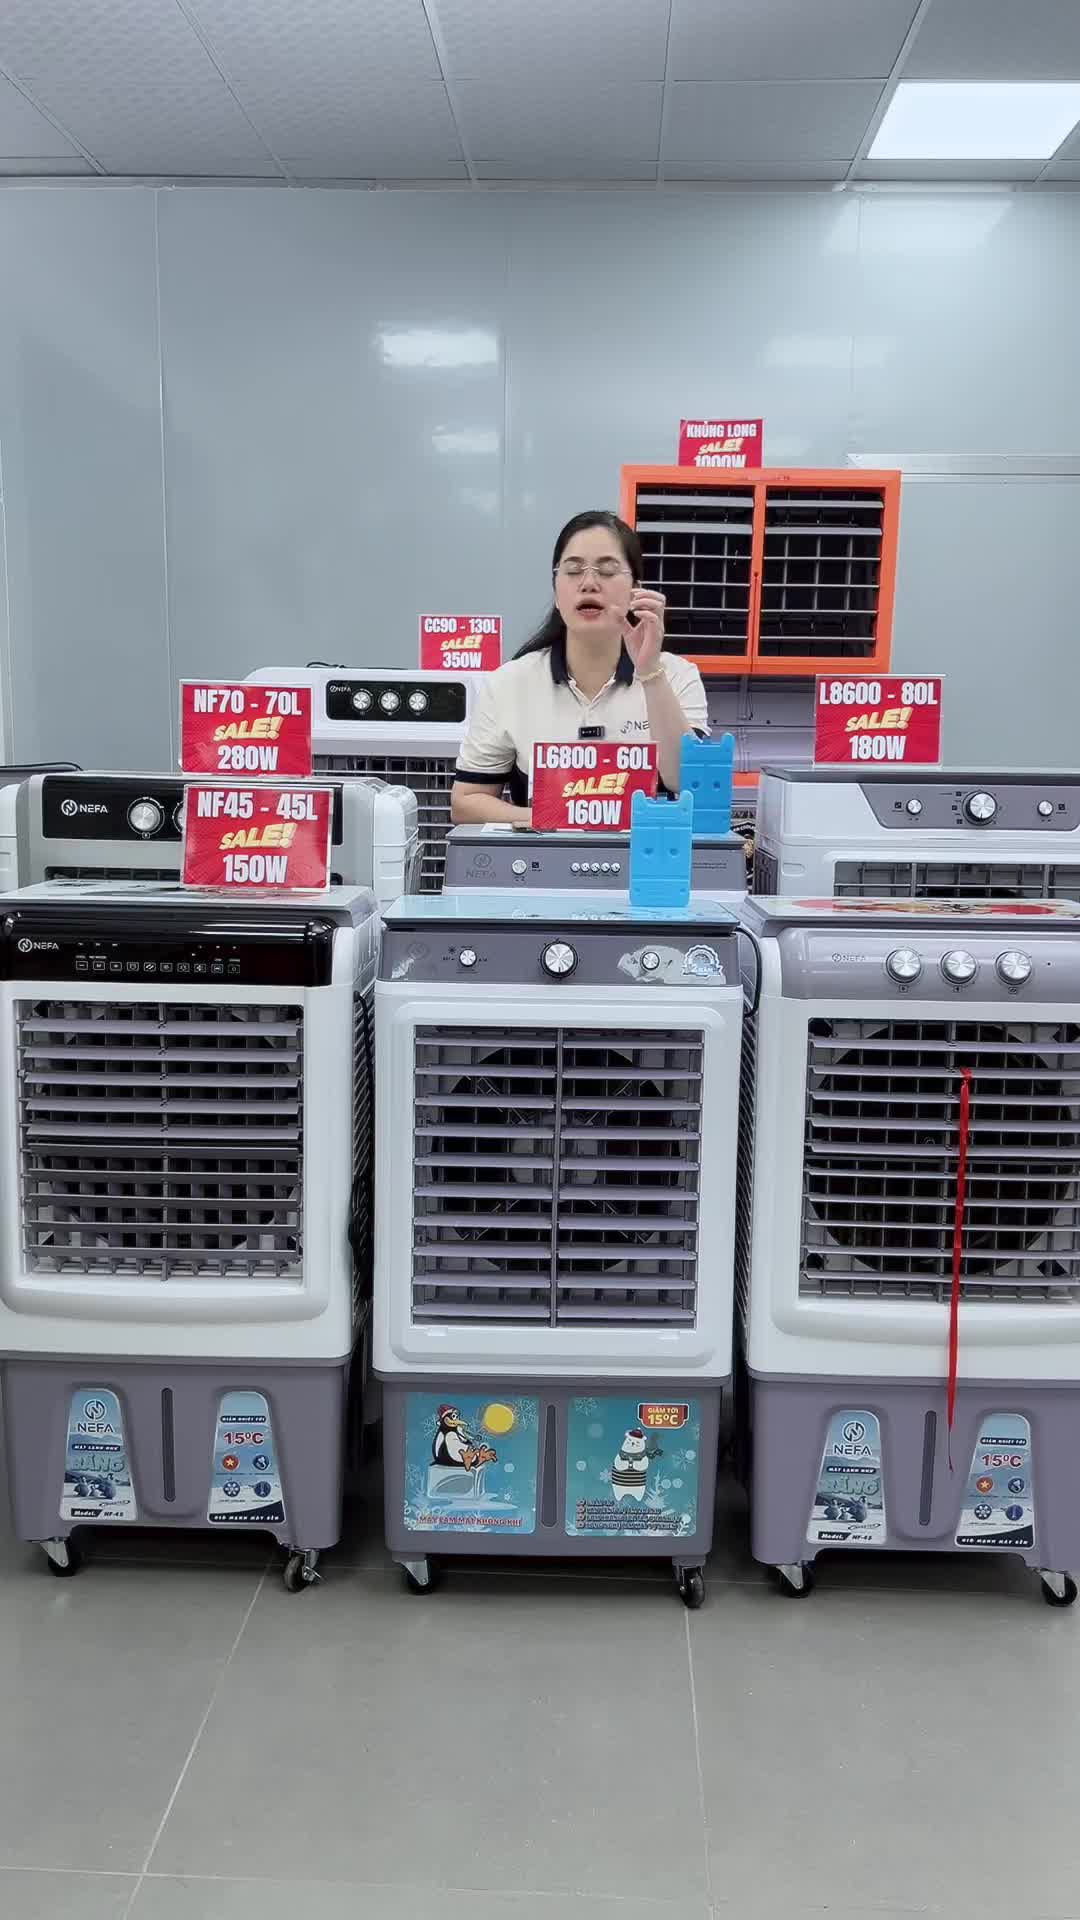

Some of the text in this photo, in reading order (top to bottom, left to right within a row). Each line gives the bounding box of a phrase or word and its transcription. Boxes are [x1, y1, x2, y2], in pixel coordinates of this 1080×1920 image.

[686, 420, 757, 438] KHỦNG LONG
[693, 454, 746, 468] 1000W
[424, 617, 457, 633] CC90
[468, 618, 498, 634] 130L
[439, 634, 484, 651] SALE!
[442, 651, 482, 668] 350W
[193, 688, 245, 714] NF70
[264, 690, 302, 715] 70L
[819, 681, 881, 705] L8600
[901, 681, 938, 705] 80L
[212, 715, 285, 742] SALE!
[844, 706, 914, 732] SALE!
[217, 744, 279, 771] 280W
[536, 745, 597, 769] L6800
[616, 746, 653, 770] 60L
[848, 734, 907, 760] 180W
[561, 772, 630, 798] SALE!
[79, 804, 108, 814] NEFA
[197, 791, 254, 819] NF45
[276, 793, 319, 821] 45L
[564, 799, 622, 825] 160W
[218, 822, 298, 850] SALE!
[222, 853, 288, 884] 150W
[33, 942, 59, 950] NEFA
[77, 1422, 114, 1433] NEFA
[834, 1444, 872, 1455] NEFA
